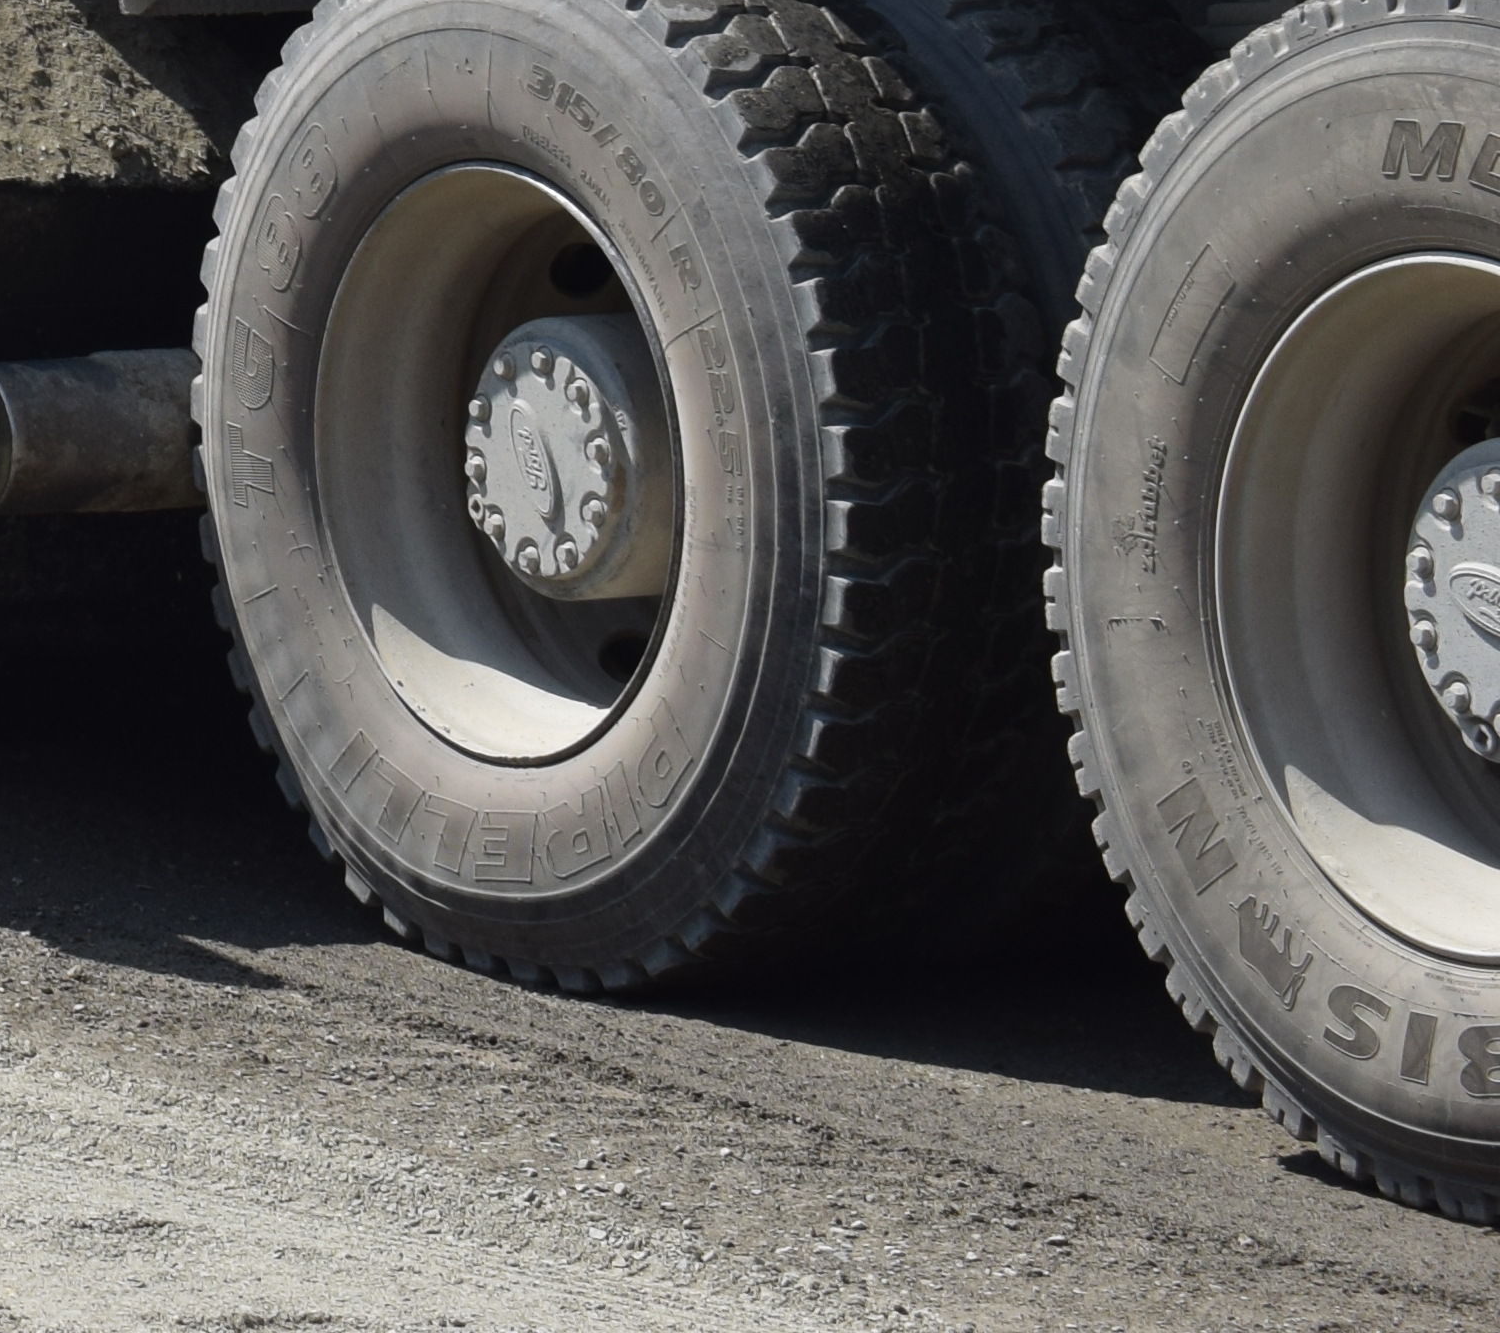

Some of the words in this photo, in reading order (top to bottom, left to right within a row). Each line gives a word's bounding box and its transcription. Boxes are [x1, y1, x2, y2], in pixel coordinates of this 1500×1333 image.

[227, 315, 276, 508] TG
[256, 122, 338, 292] 88
[329, 695, 694, 883] PIRELLI
